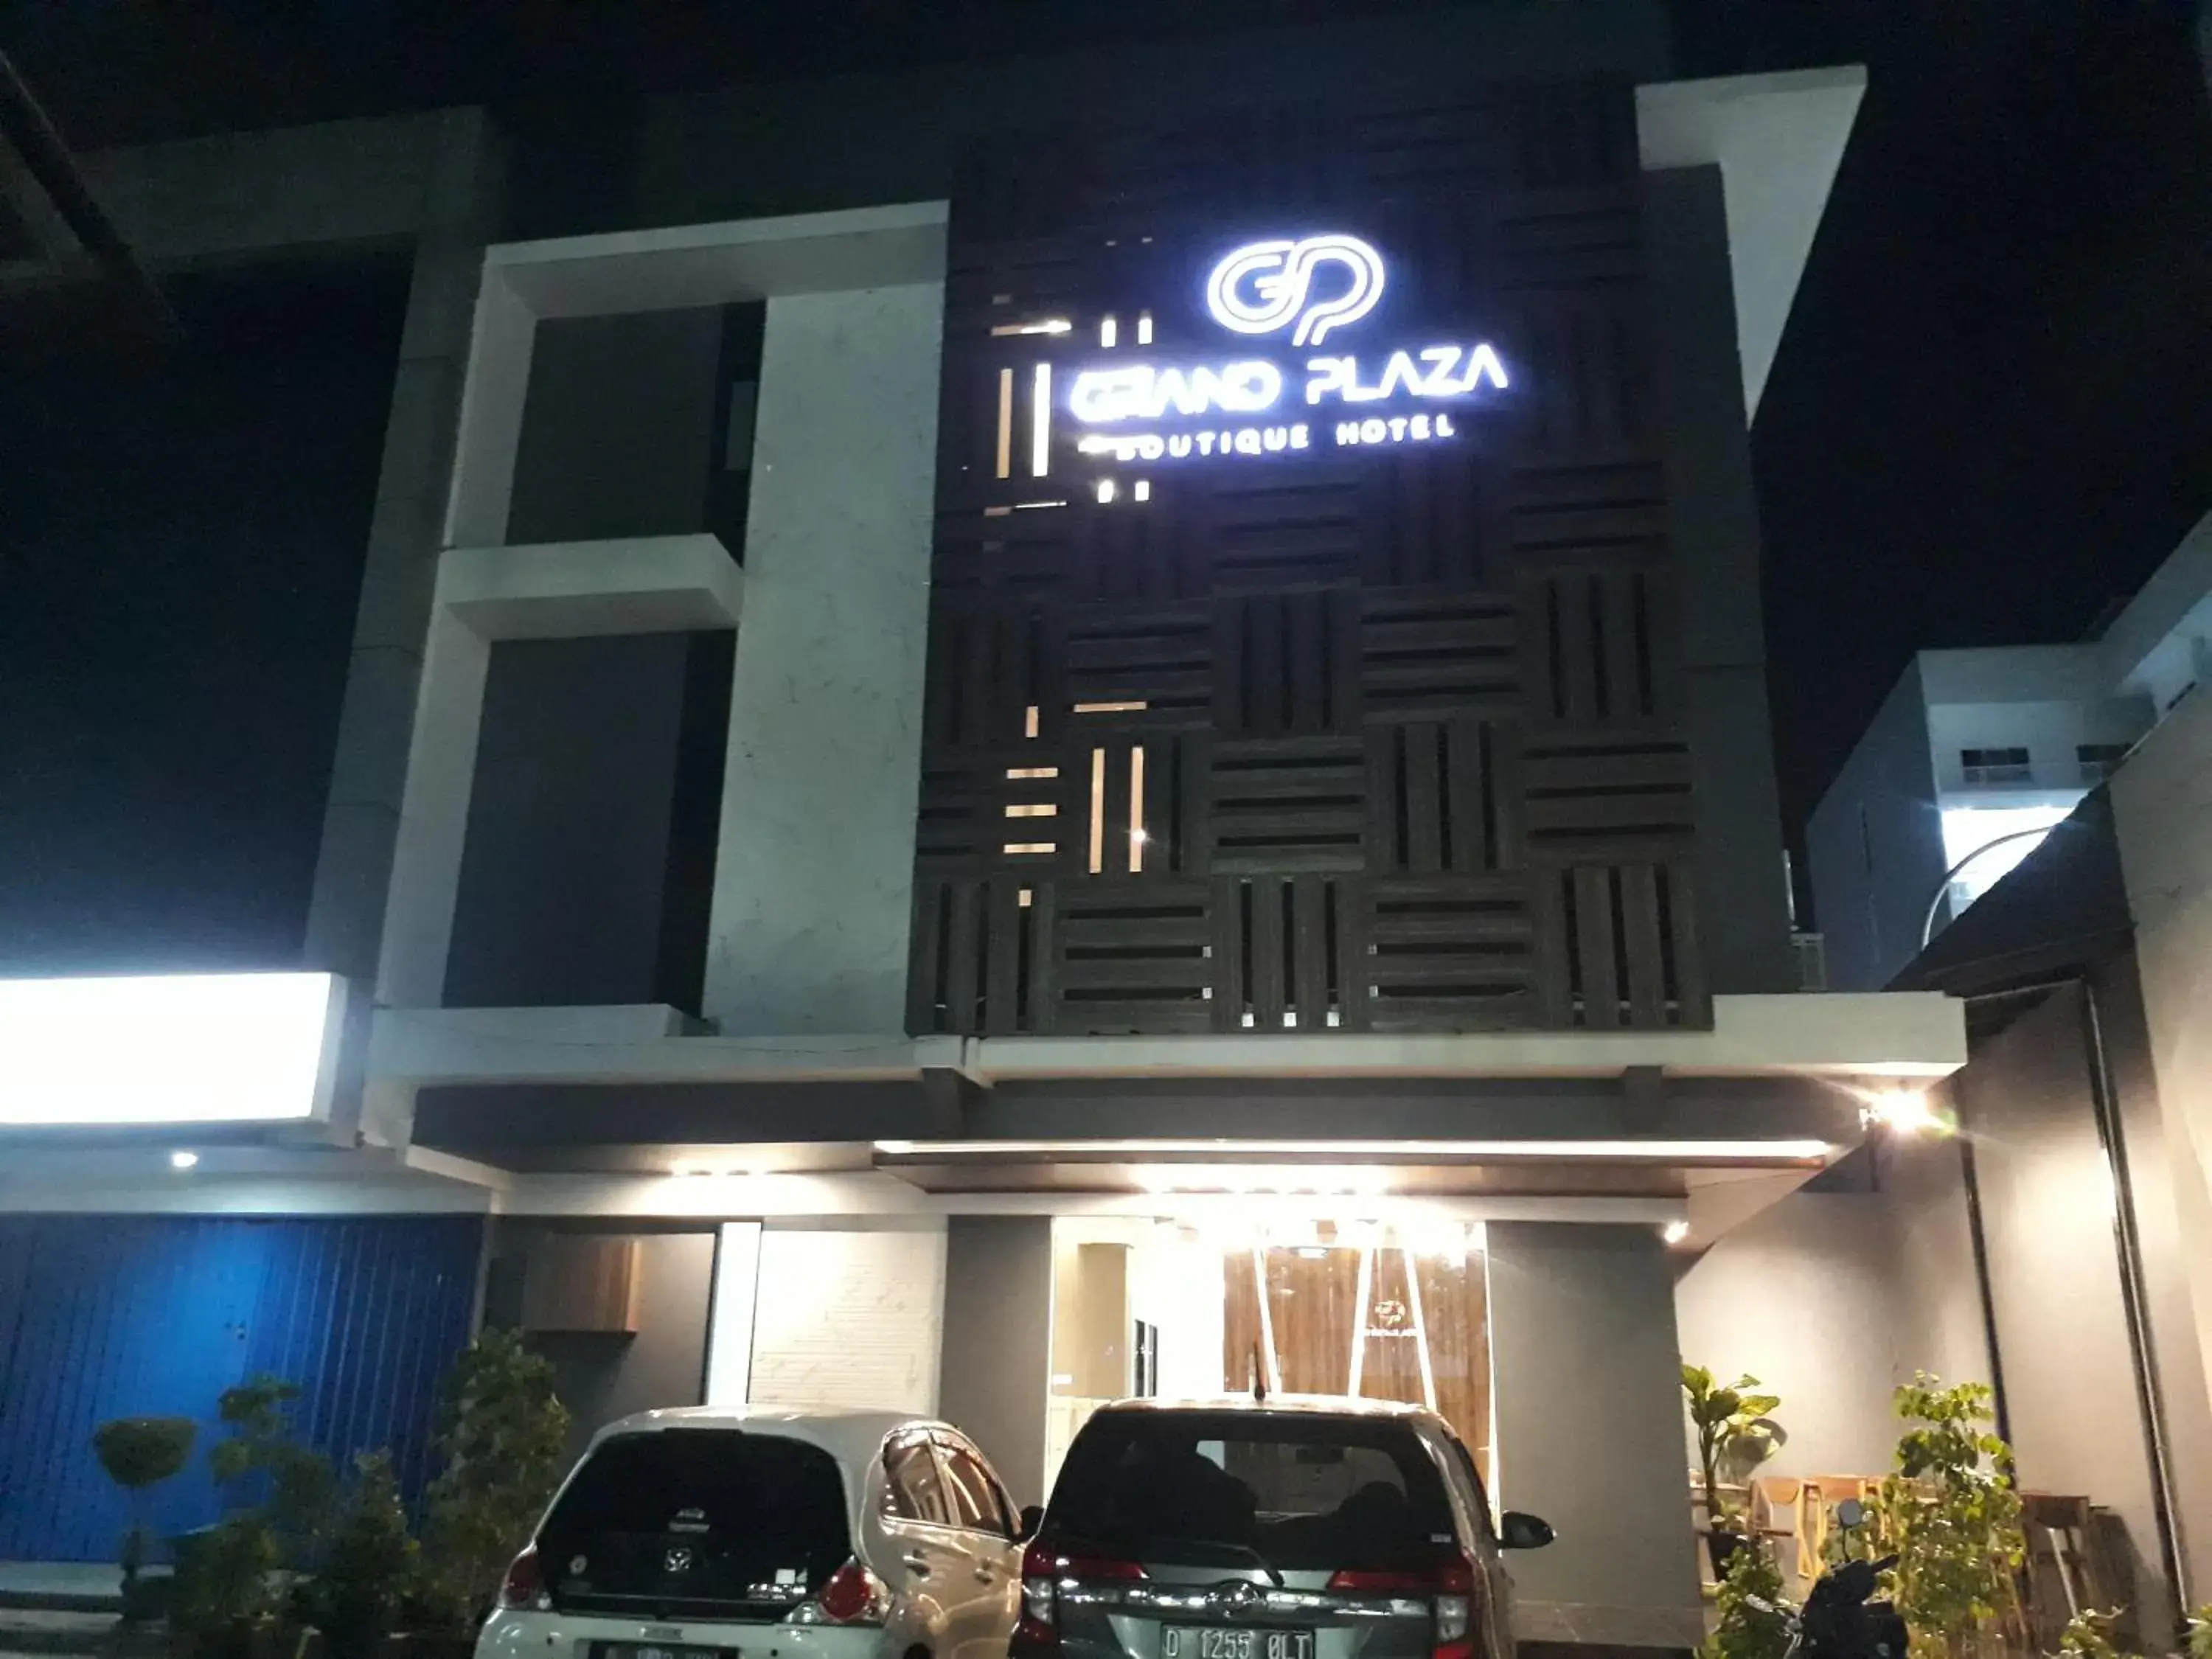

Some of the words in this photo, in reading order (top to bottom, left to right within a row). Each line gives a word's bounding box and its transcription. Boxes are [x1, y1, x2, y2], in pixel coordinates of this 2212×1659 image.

[1208, 234, 1384, 347] GP
[1071, 361, 1281, 422] GRAND
[1306, 344, 1509, 405] PLAZA
[1335, 413, 1455, 446] HOTEL
